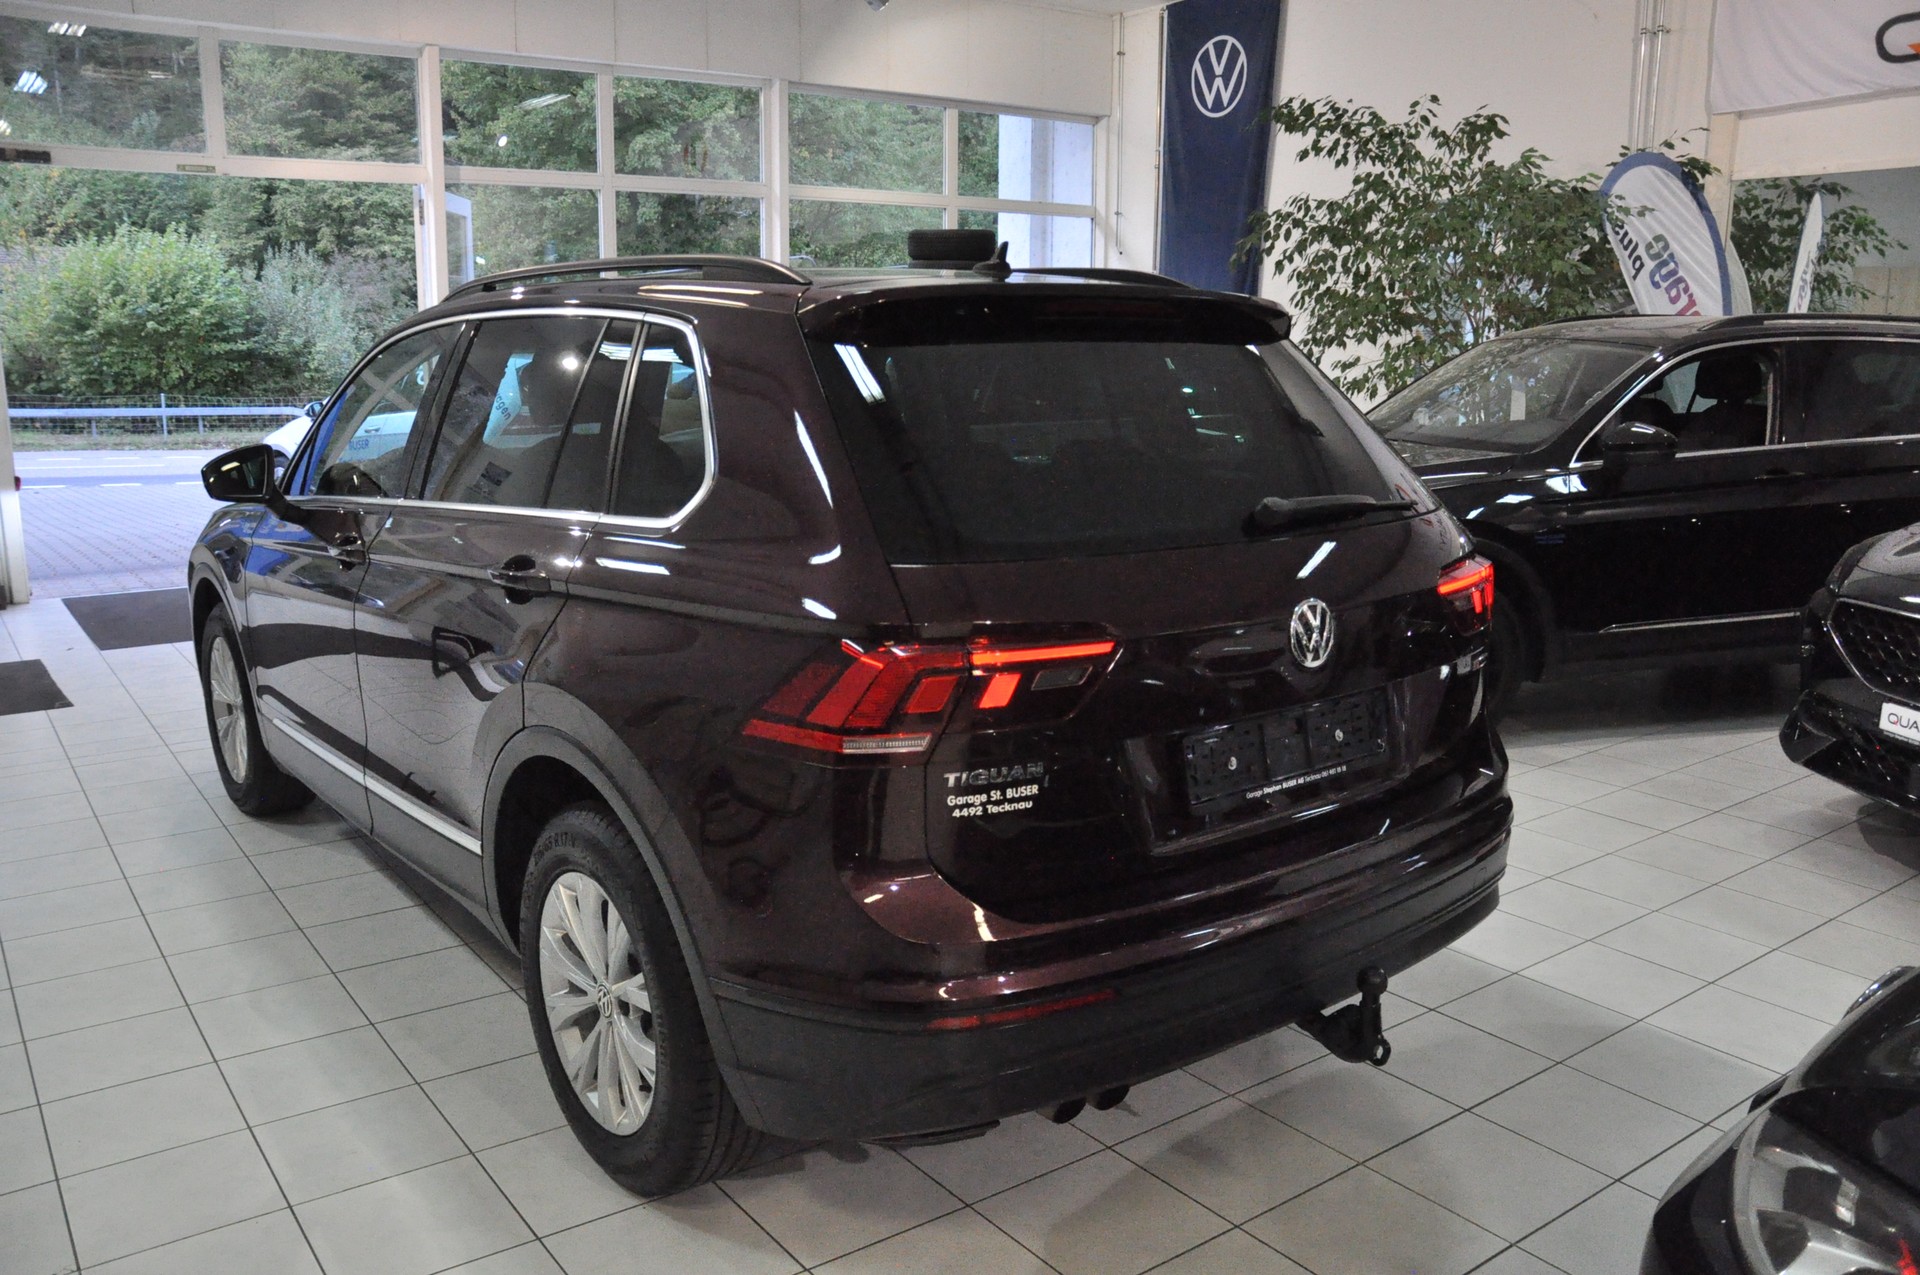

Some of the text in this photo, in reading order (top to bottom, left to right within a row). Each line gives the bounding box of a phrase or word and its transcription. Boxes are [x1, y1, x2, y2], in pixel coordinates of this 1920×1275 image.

[944, 762, 1044, 788] TIGUAN
[947, 784, 1039, 806] Garage St. BUSER
[952, 800, 1033, 818] 4492 Tecknau
